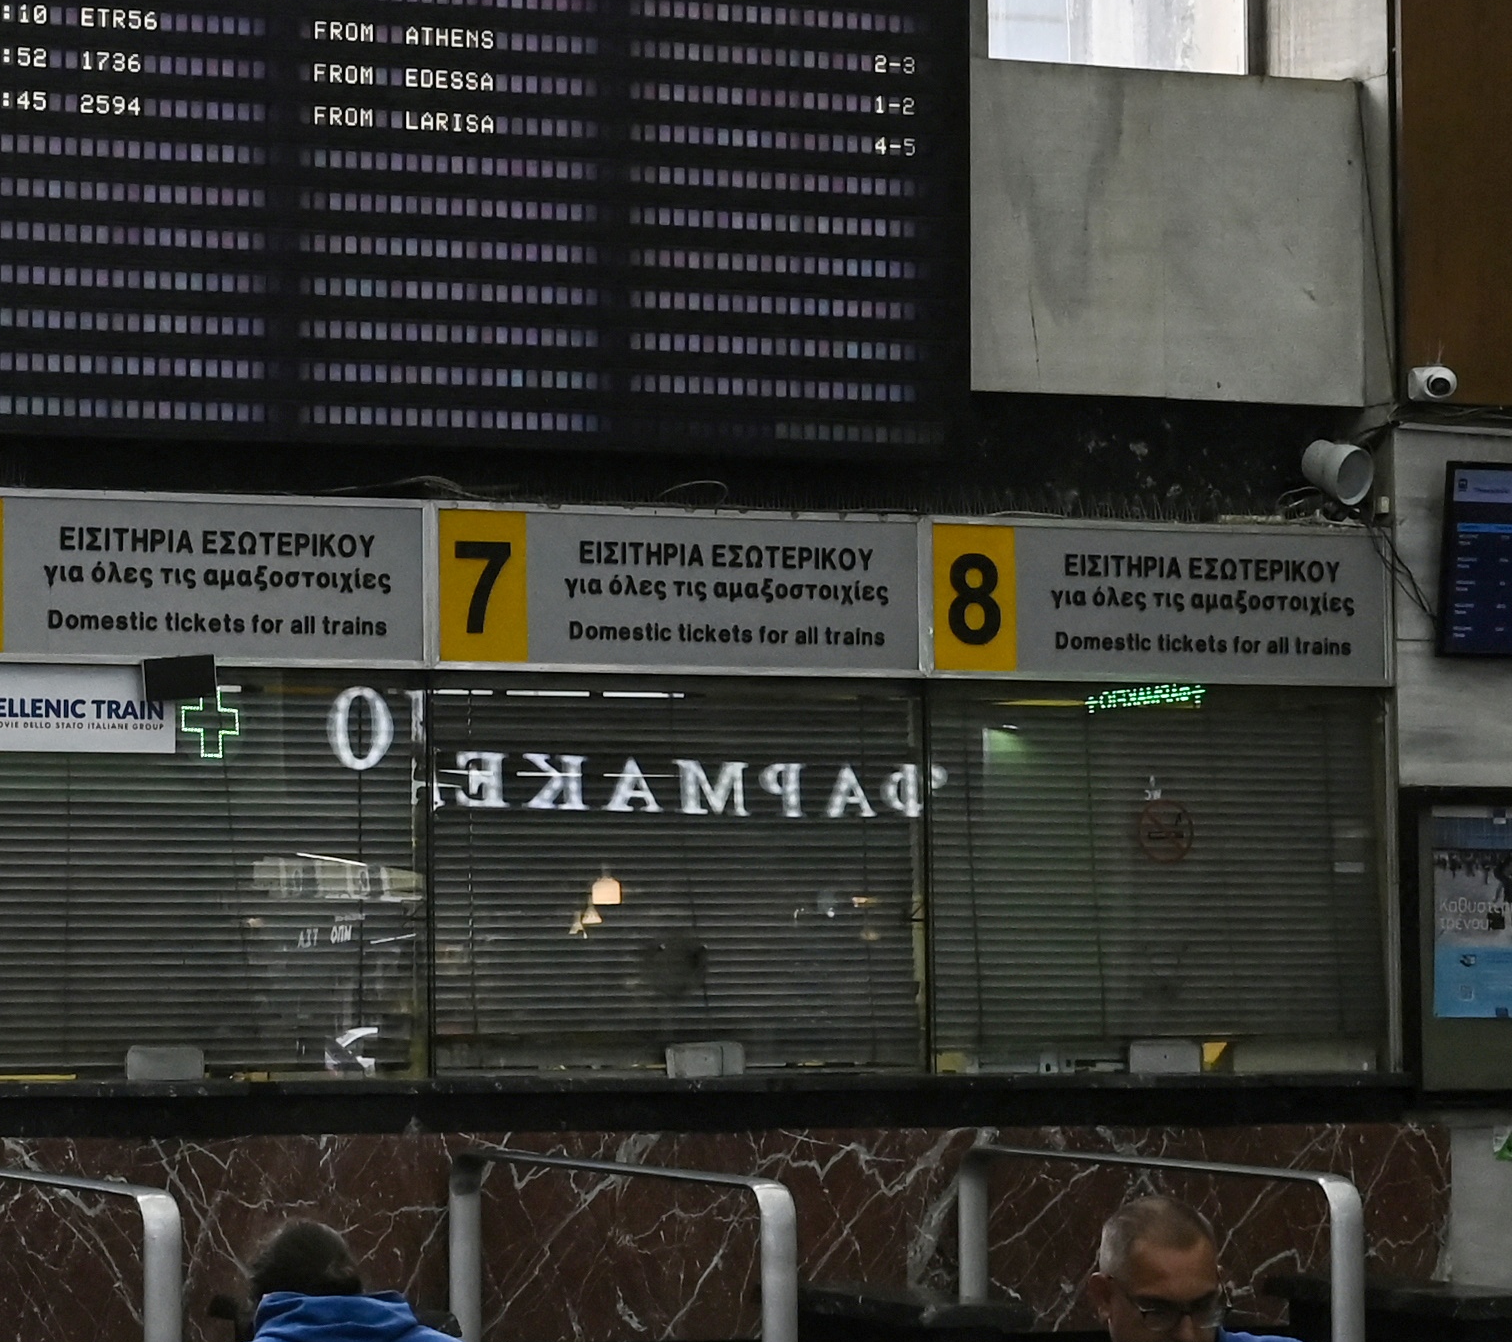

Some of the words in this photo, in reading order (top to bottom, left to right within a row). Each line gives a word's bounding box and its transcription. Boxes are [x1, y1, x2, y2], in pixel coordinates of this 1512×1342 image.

[81, 7, 158, 31] ETR56
[314, 20, 374, 43] FROM
[405, 26, 494, 50] ATHENS
[874, 54, 915, 74] 2-3
[82, 50, 141, 73] 1736
[313, 63, 373, 85] FROM
[405, 68, 494, 91] EDESSA
[875, 95, 915, 115] 1-2
[80, 94, 141, 116] 2594
[314, 106, 373, 127] FROM
[405, 110, 494, 134] LARISA
[874, 136, 916, 156] 4-5
[59, 526, 194, 554] ΕΙΣΙΤΗΡΙΑ
[202, 530, 375, 559] ΕΣΩΤΕΡΙΚΟΥ
[579, 540, 704, 567] ΕΙΣΙΤΗΡΙΑ
[711, 544, 874, 572] ΕΣΩΤΕΡΙΚΟΥ
[1064, 553, 1182, 579] ΕΙΣΙΤΗΡΙΑ
[1188, 557, 1340, 584] ΕΣΩΤΕΡΙΚΟΥ
[454, 540, 512, 634] 7
[948, 552, 1002, 646] 8
[90, 694, 169, 721] TRAIN
